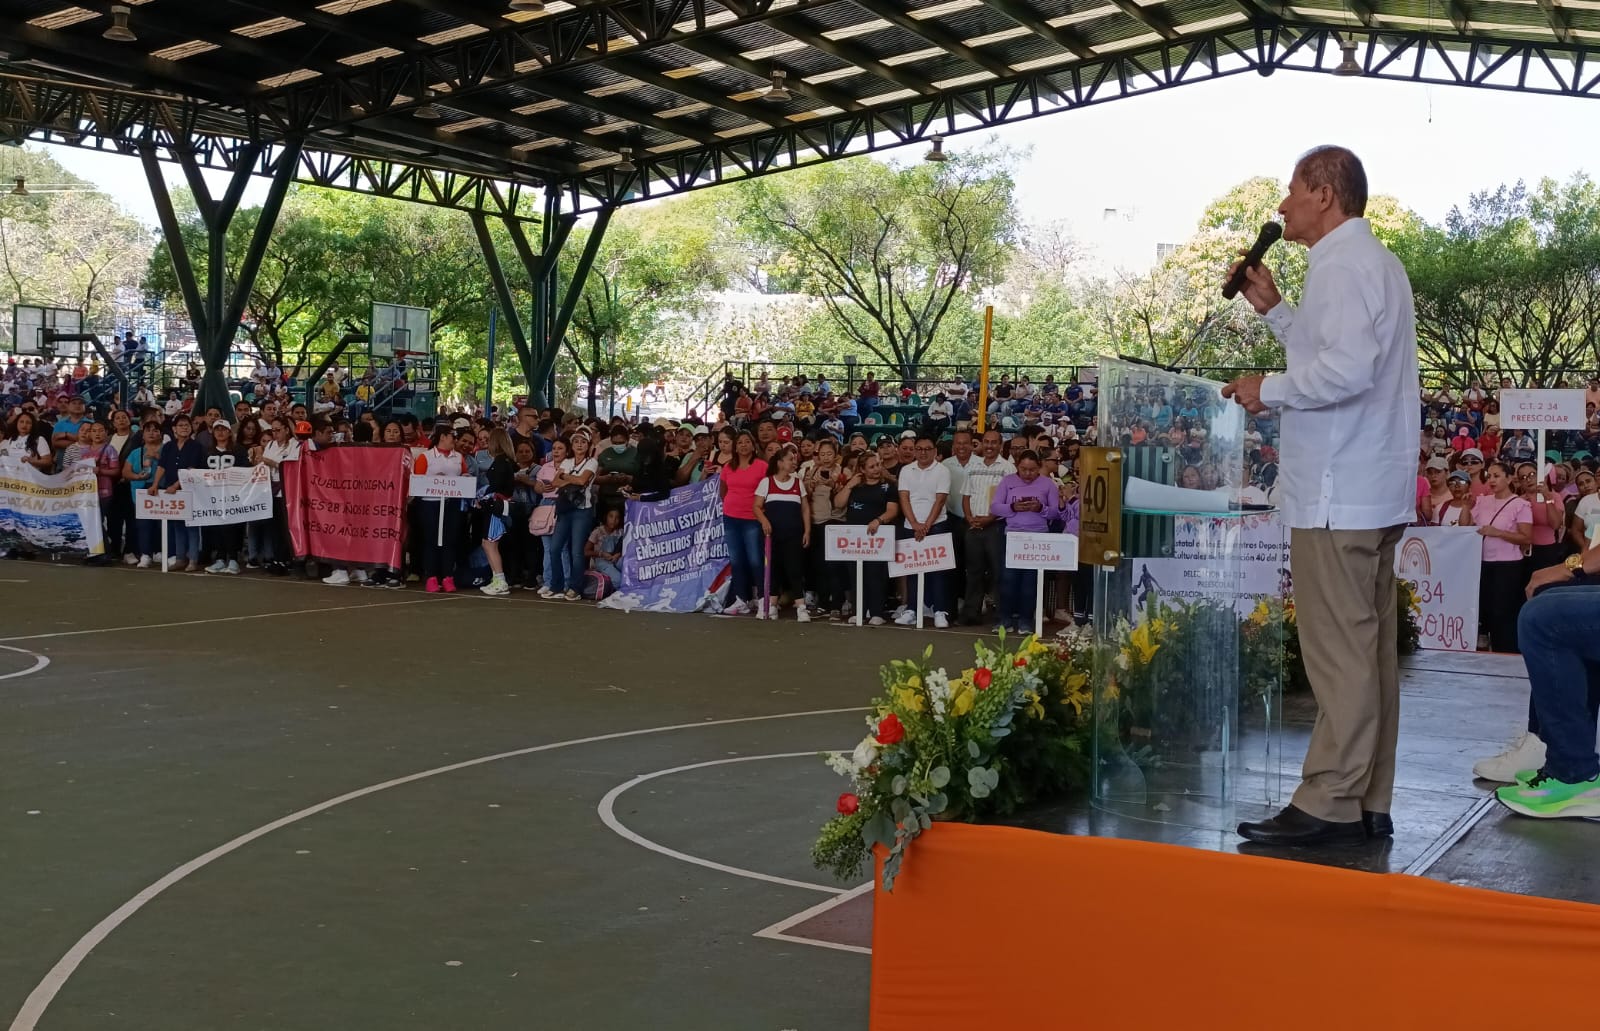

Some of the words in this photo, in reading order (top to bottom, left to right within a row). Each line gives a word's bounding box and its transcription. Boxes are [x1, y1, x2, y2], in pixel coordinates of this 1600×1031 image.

[1511, 414, 1569, 422] PREESCOLAR
[433, 478, 456, 487] D-I-10
[425, 488, 462, 497] PRIMARIA
[1083, 474, 1107, 514] 40
[144, 500, 185, 510] D-I-35
[192, 508, 225, 519] CENTRO
[225, 503, 268, 516] PONIENTE
[633, 518, 677, 540] JORNADA
[636, 534, 692, 560] ENCUENTROS
[836, 537, 885, 549] D-I-17
[895, 546, 947, 564] D-I-112
[1013, 553, 1061, 561] PREESCOLAR
[904, 560, 940, 569] PRIMARIA
